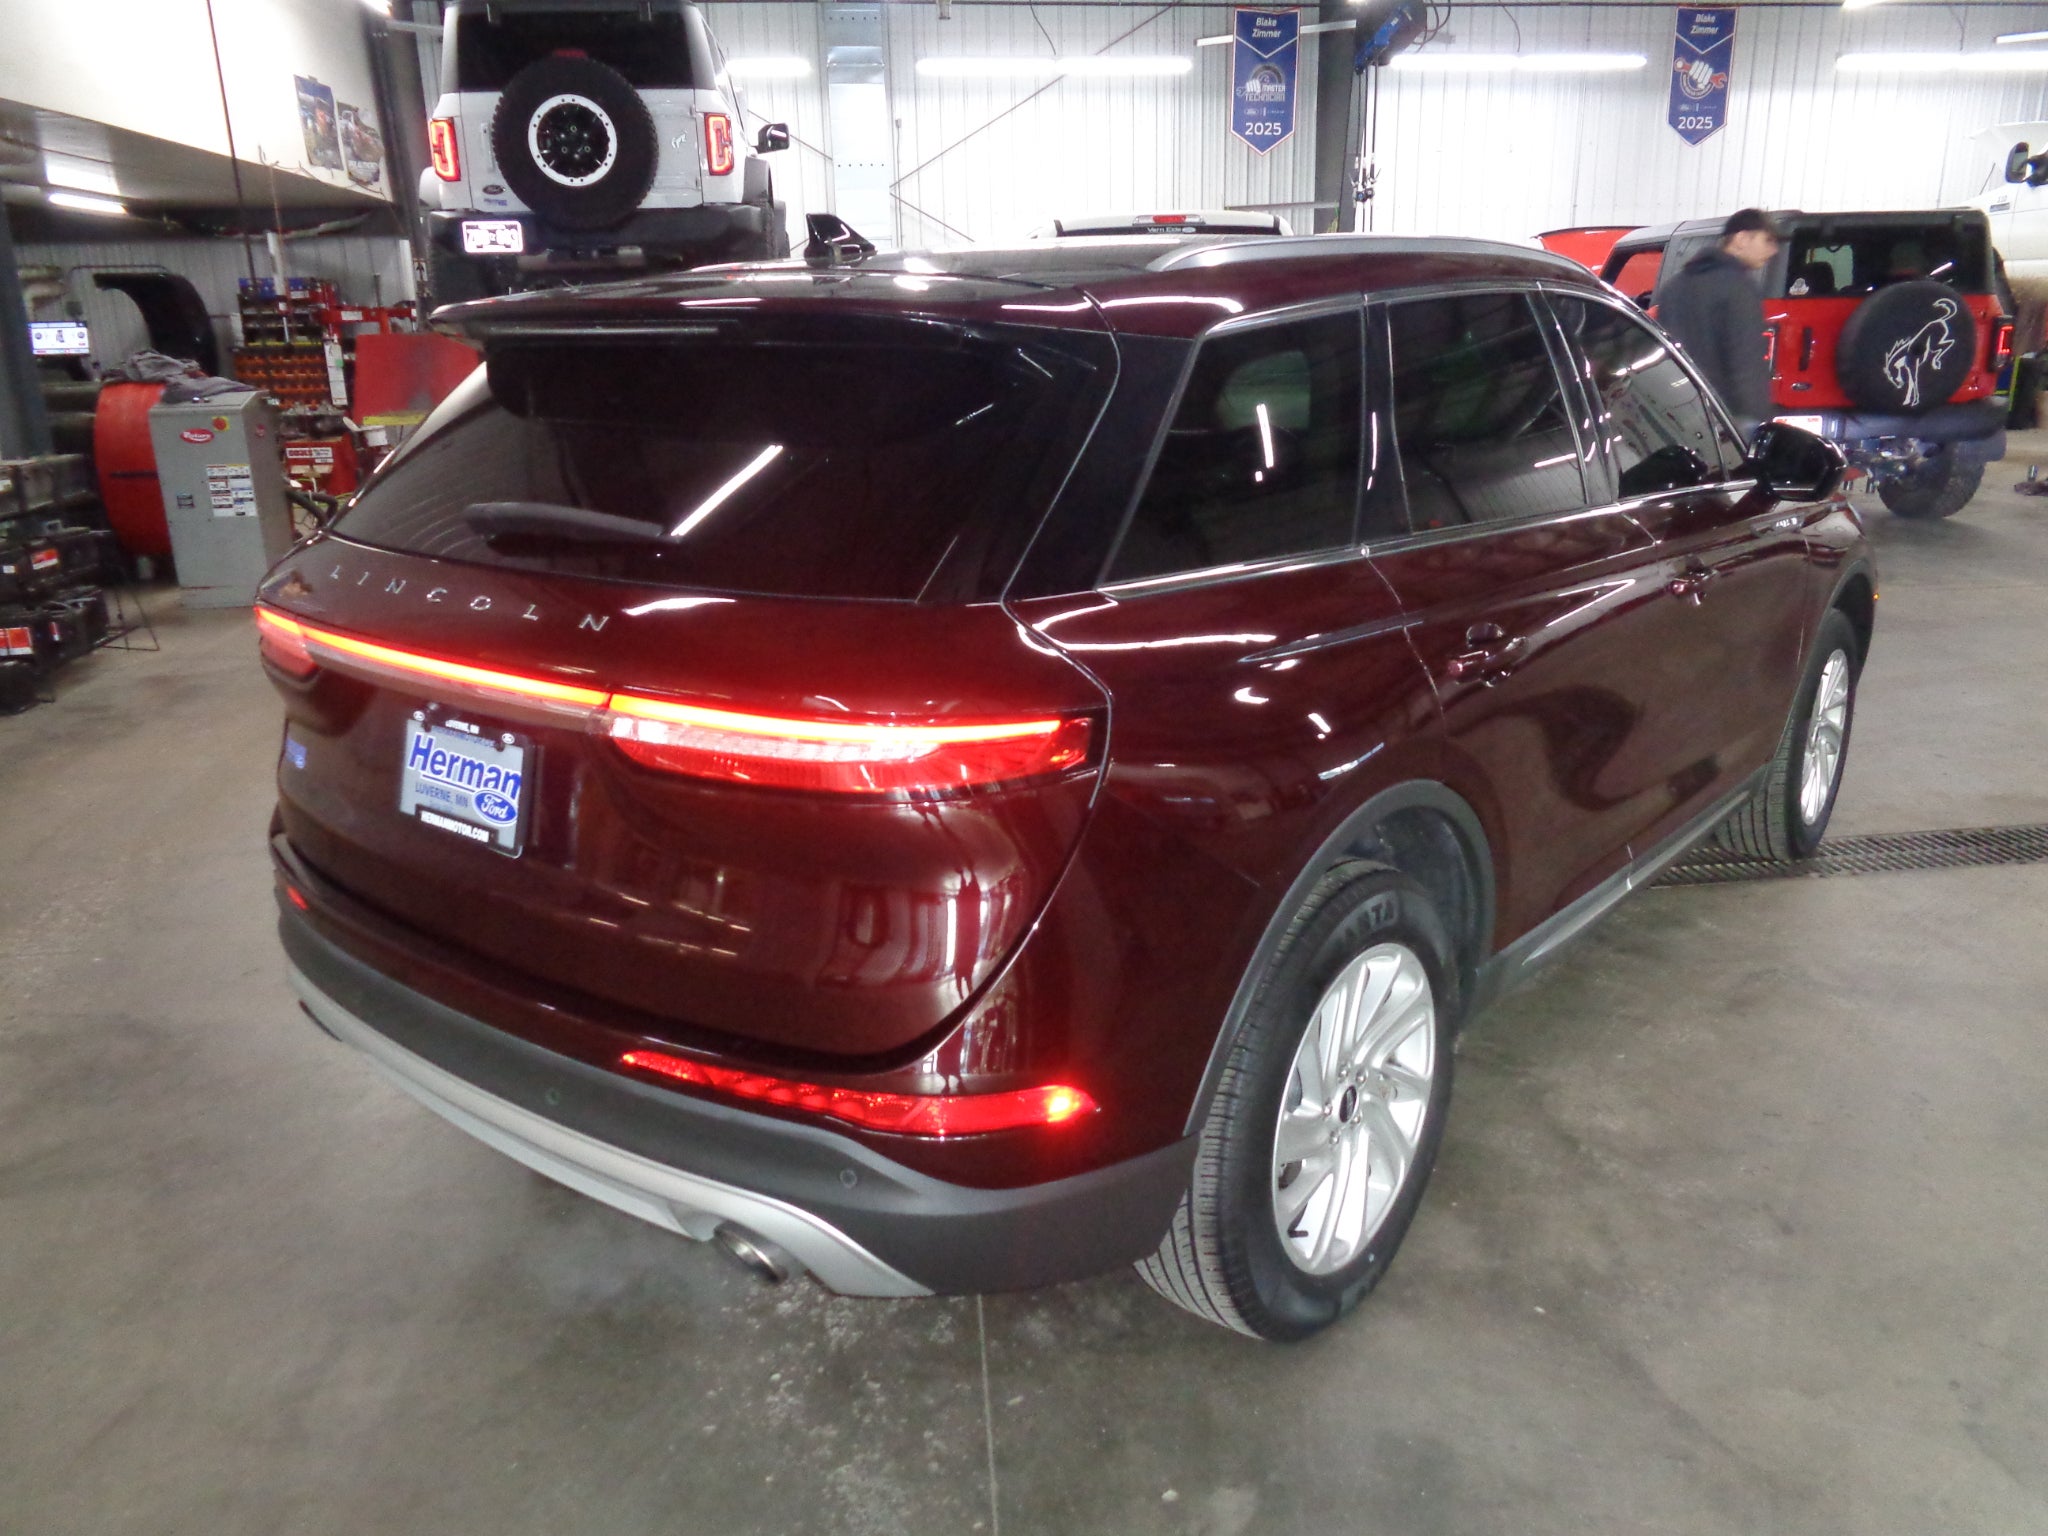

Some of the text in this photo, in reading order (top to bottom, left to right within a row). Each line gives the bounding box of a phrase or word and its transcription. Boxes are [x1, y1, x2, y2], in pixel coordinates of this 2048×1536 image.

[1256, 17, 1277, 27] Blake
[1695, 13, 1716, 23] Blake
[1252, 28, 1281, 38] Zimmer
[1690, 25, 1719, 34] Zimmer
[1262, 83, 1285, 92] MASTER
[1245, 92, 1286, 102] TECHNICIAN
[1677, 116, 1713, 129] 2025
[1245, 122, 1282, 135] 2025
[329, 564, 610, 632] LINCOLN
[408, 732, 522, 800] Herman
[480, 793, 508, 820] Ford
